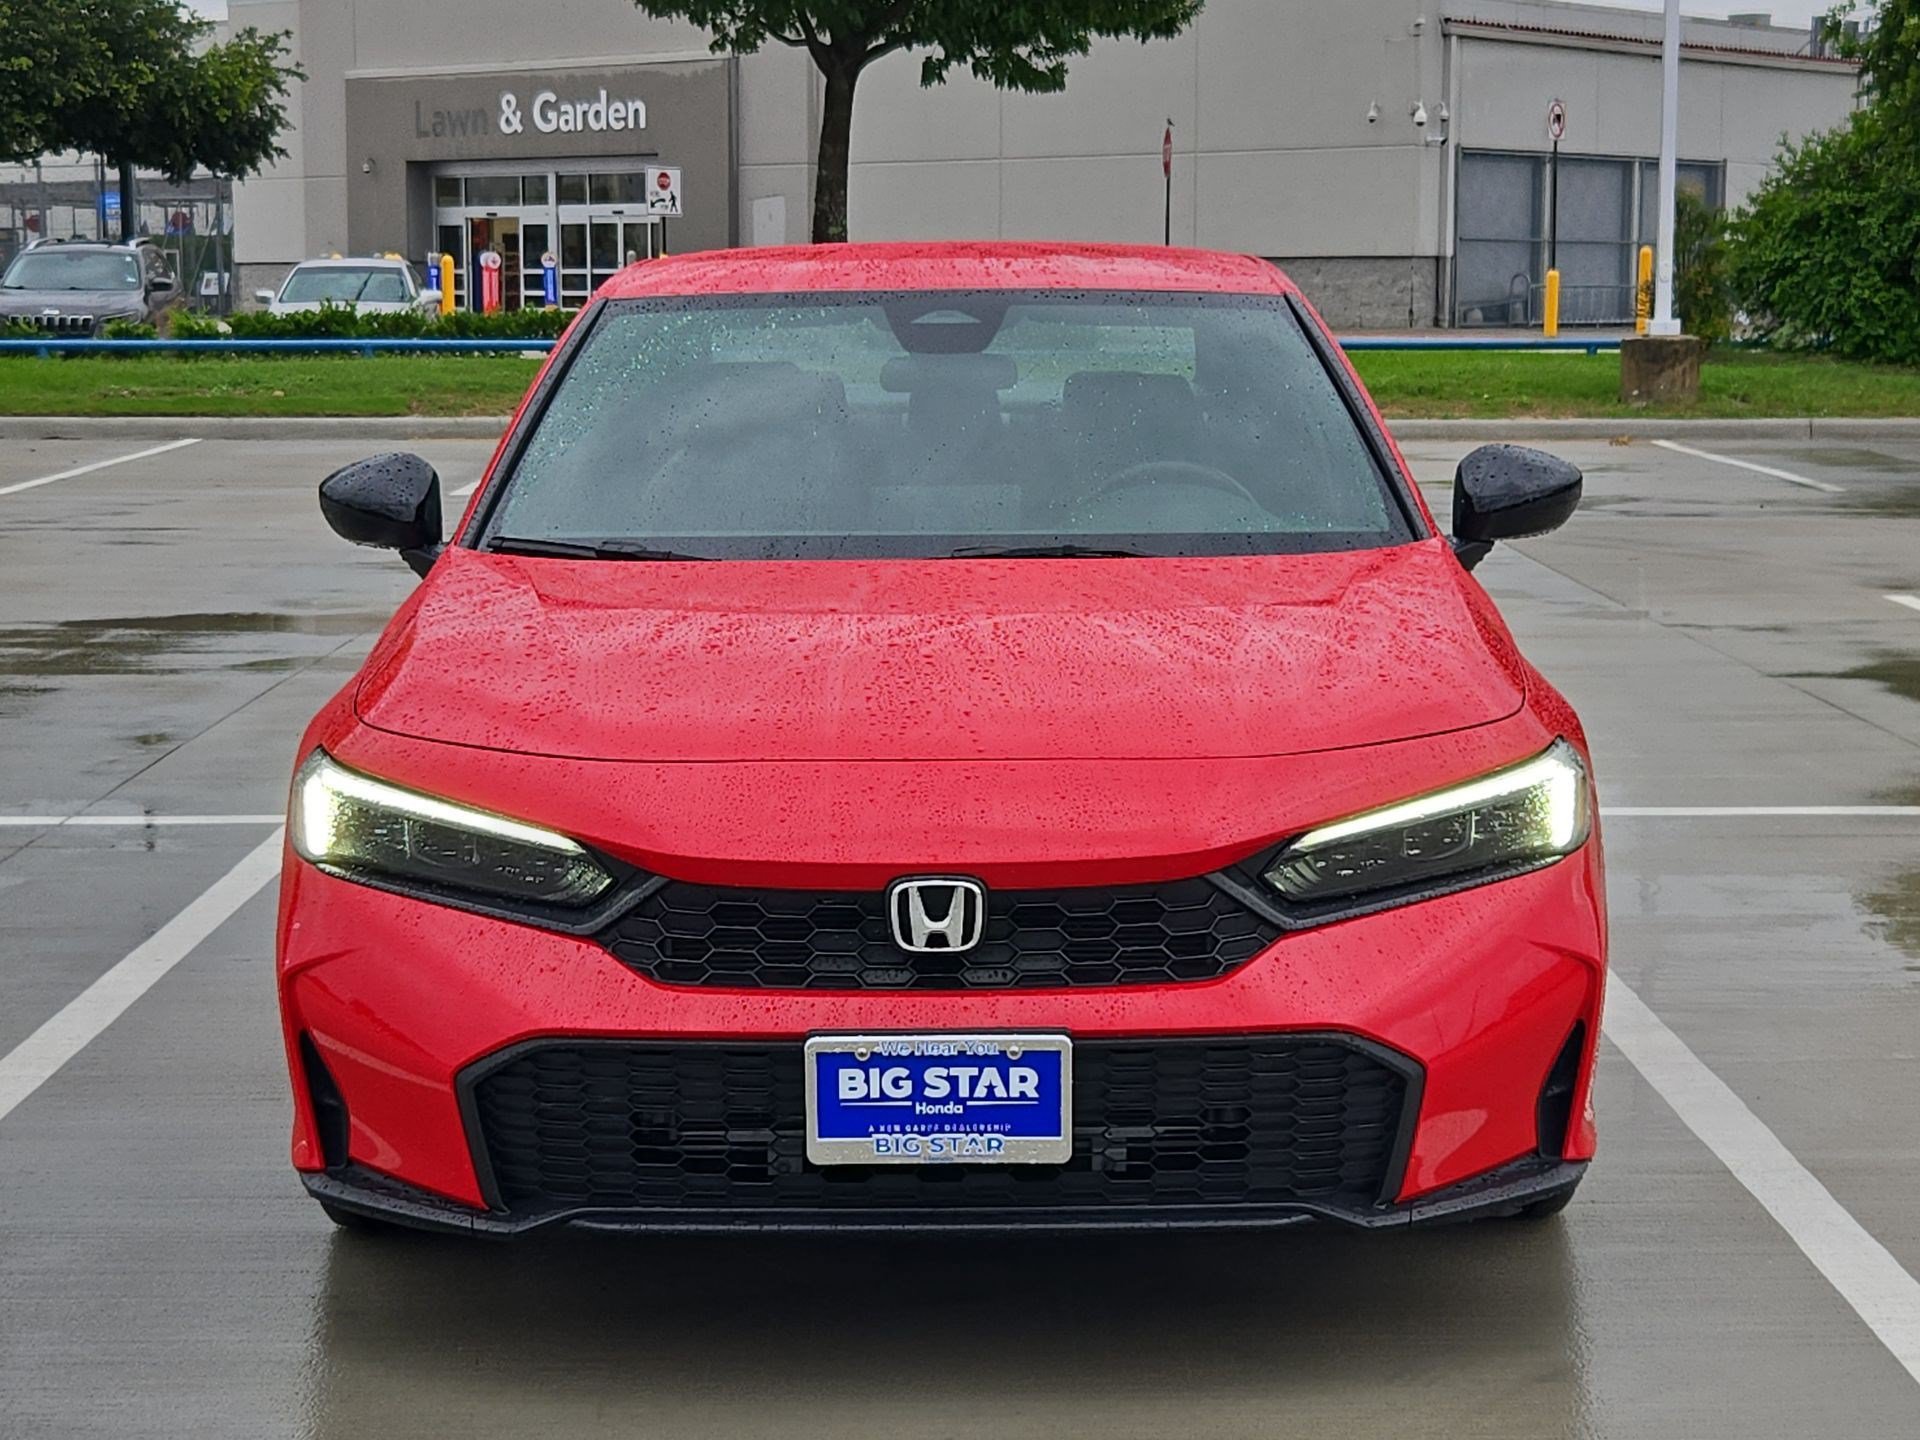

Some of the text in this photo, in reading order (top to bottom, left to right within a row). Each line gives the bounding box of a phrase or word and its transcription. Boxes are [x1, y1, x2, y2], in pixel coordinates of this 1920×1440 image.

[415, 89, 646, 138] Lawn & Garden
[880, 1040, 1000, 1056] We Hear You
[838, 1067, 1039, 1099] BIG STAR
[915, 1101, 963, 1115] Honda
[874, 1136, 1004, 1153] BIG STAR
